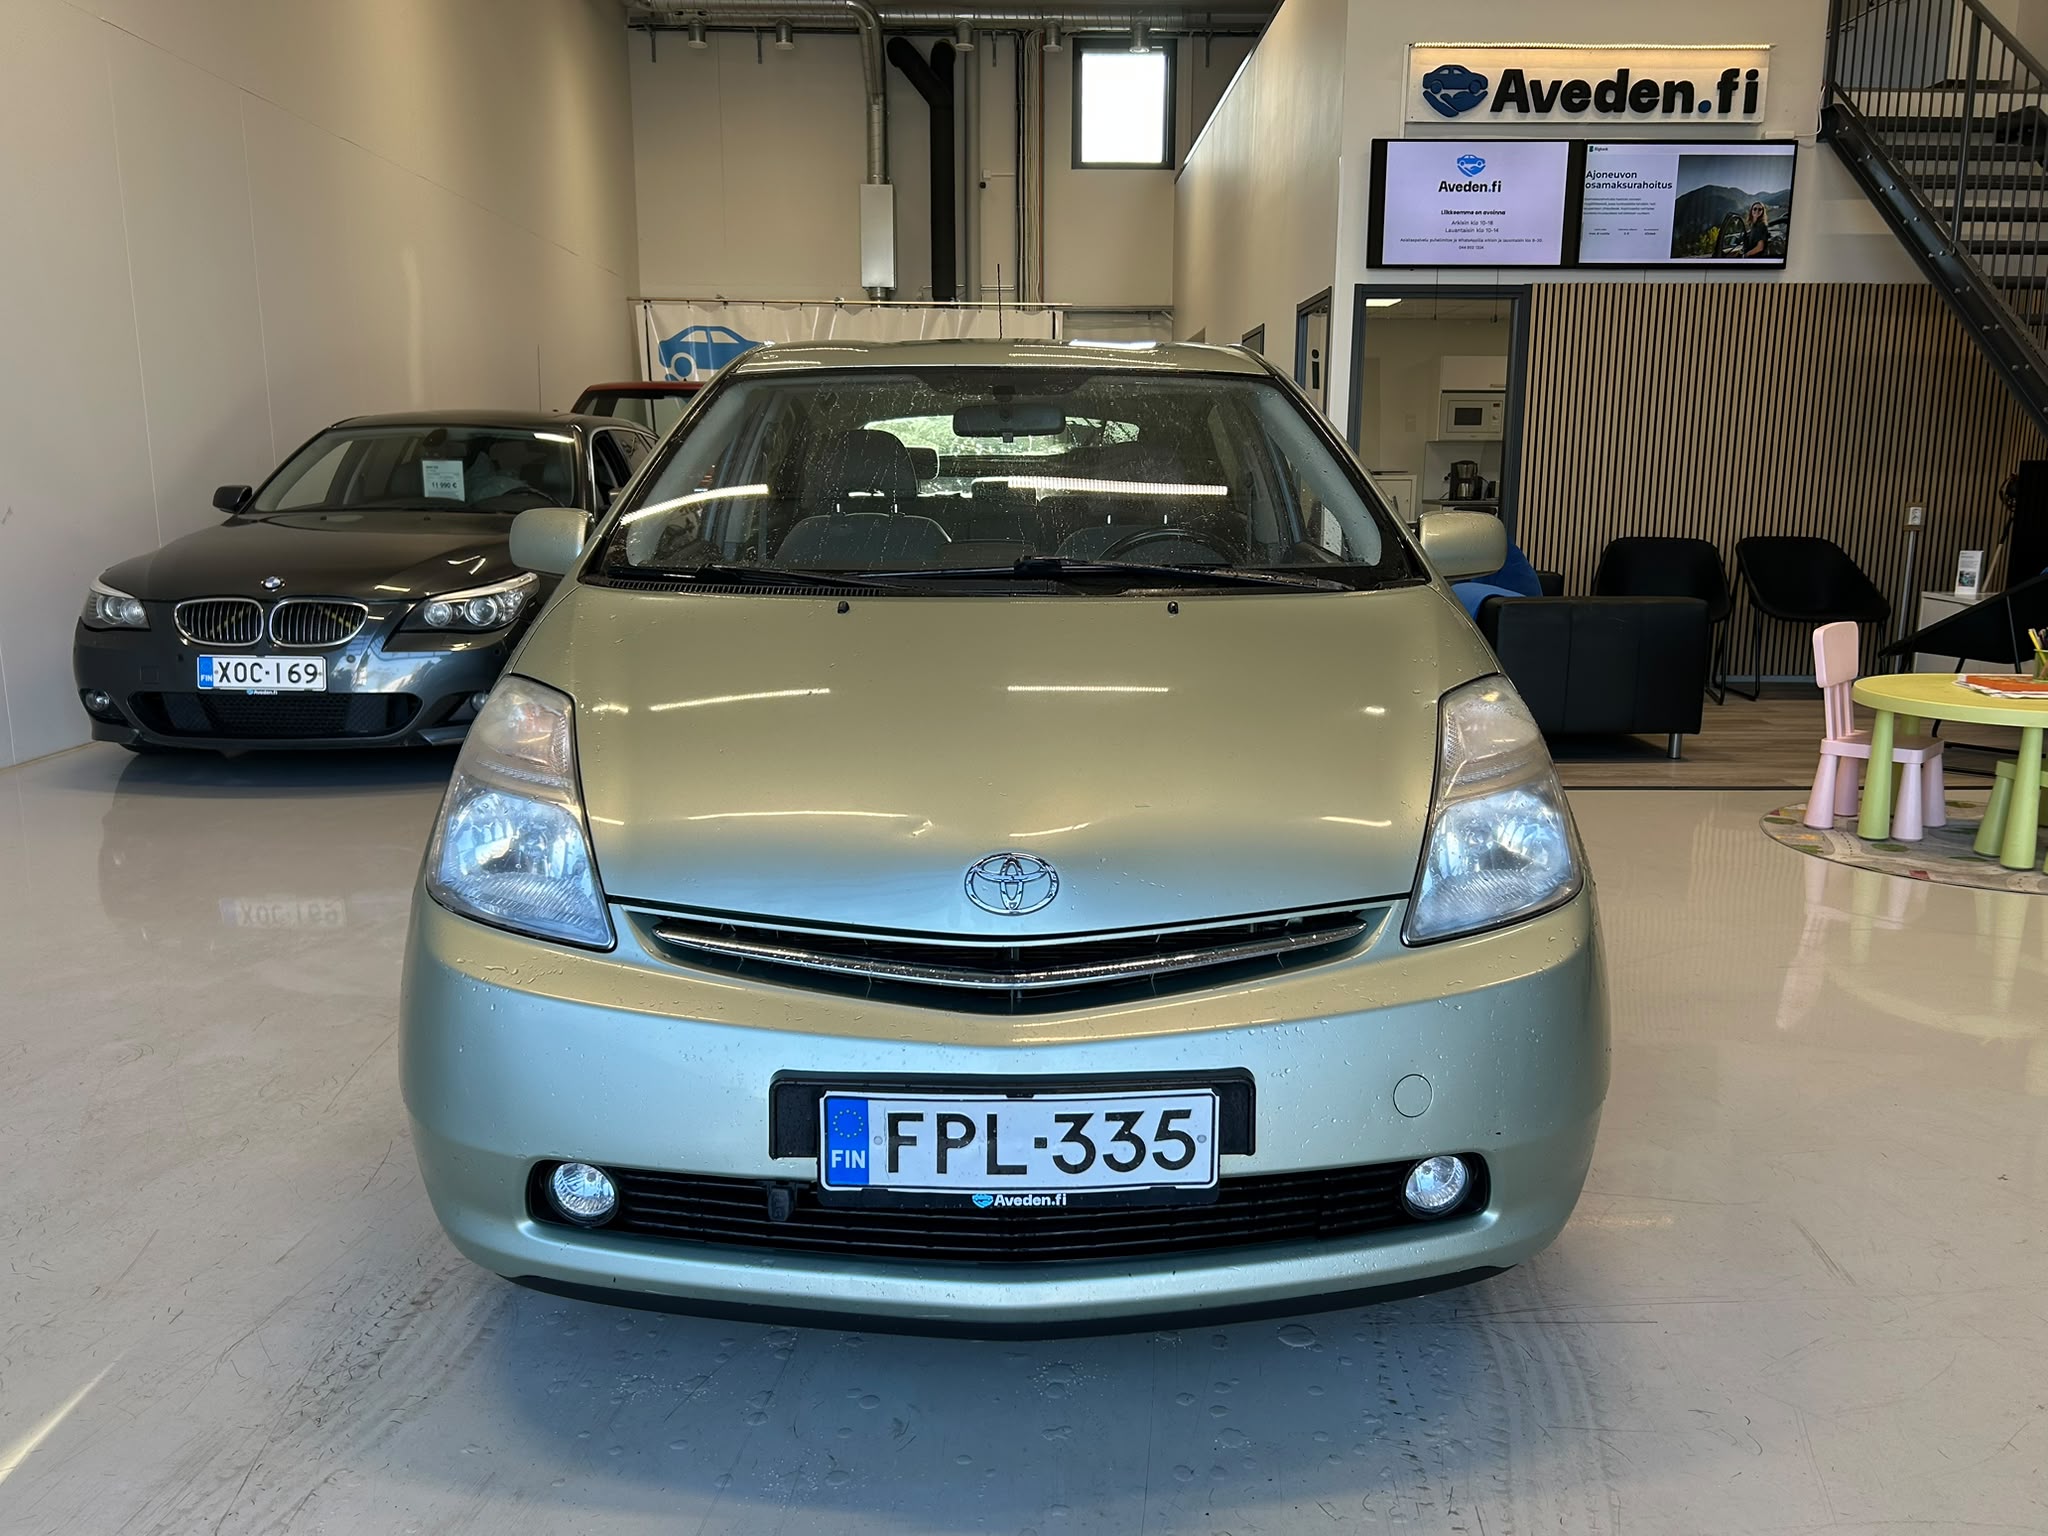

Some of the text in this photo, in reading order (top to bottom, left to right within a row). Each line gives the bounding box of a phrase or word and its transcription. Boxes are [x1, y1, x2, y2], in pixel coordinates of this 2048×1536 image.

[1490, 67, 1760, 115] Aveden.fi
[1585, 170, 1637, 180] Ajoneuvon
[1438, 180, 1502, 193] Aveden.fi
[1585, 181, 1673, 189] osamaksurahoitus
[200, 674, 213, 682] FIN
[830, 1150, 867, 1169] FIN
[994, 1193, 1068, 1207] Aveden.fi
